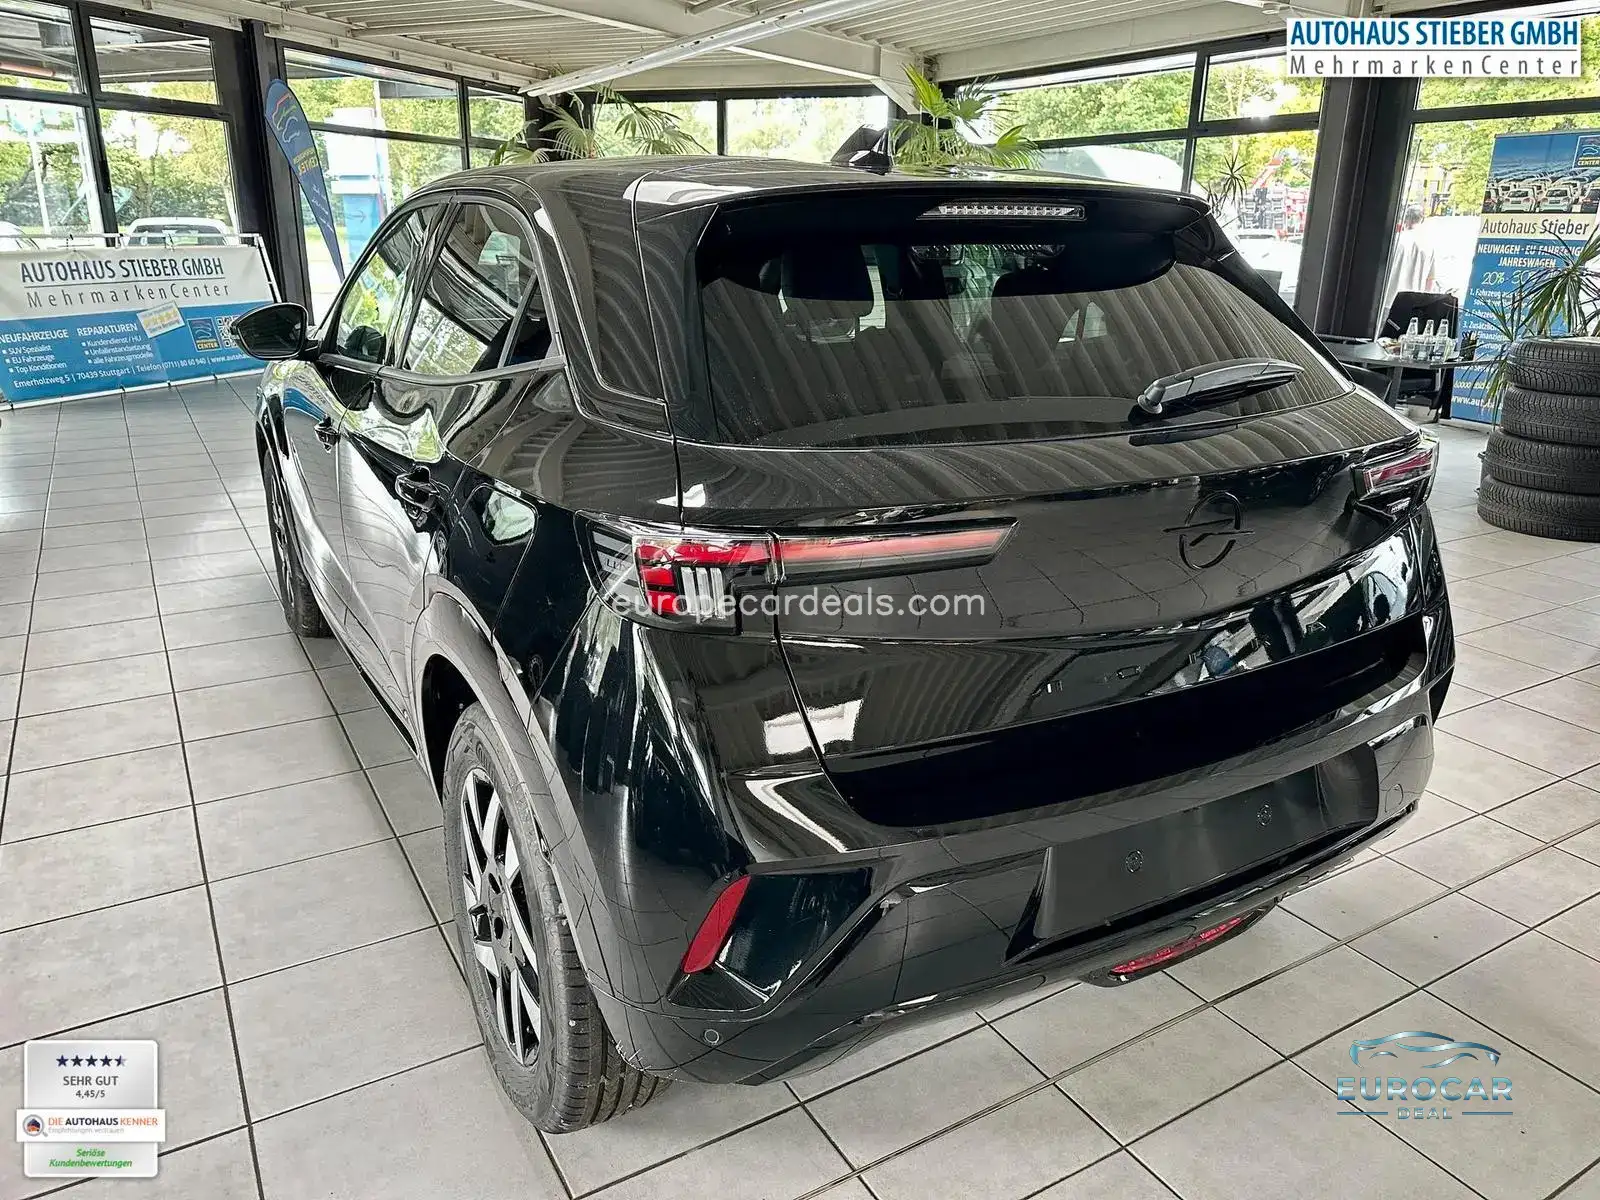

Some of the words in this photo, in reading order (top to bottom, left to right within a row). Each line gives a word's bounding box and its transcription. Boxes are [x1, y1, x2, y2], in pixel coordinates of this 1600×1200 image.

[1481, 218, 1538, 234] Autohaus
[1540, 218, 1590, 235] Stieber
[1478, 244, 1520, 254] NEUWAGEN
[1524, 245, 1537, 255] EU
[1498, 256, 1556, 268] JAHRESWAGEN
[21, 260, 116, 282] AUTOHAUS
[118, 258, 180, 278] STIEBER
[182, 258, 224, 276] GMBH
[26, 284, 230, 308] MehrmarkenCenter
[77, 323, 138, 336] REPARATUREN
[87, 337, 128, 347] Kundendienst
[22, 344, 52, 354] Spezialist
[22, 354, 56, 362] Fahrzeuge
[15, 366, 28, 374] Top
[28, 362, 68, 372] Konditionen
[14, 376, 65, 388] Emerholzweg
[77, 370, 98, 380] 70439
[100, 368, 130, 377] Stuttgart
[136, 364, 161, 372] Telefon
